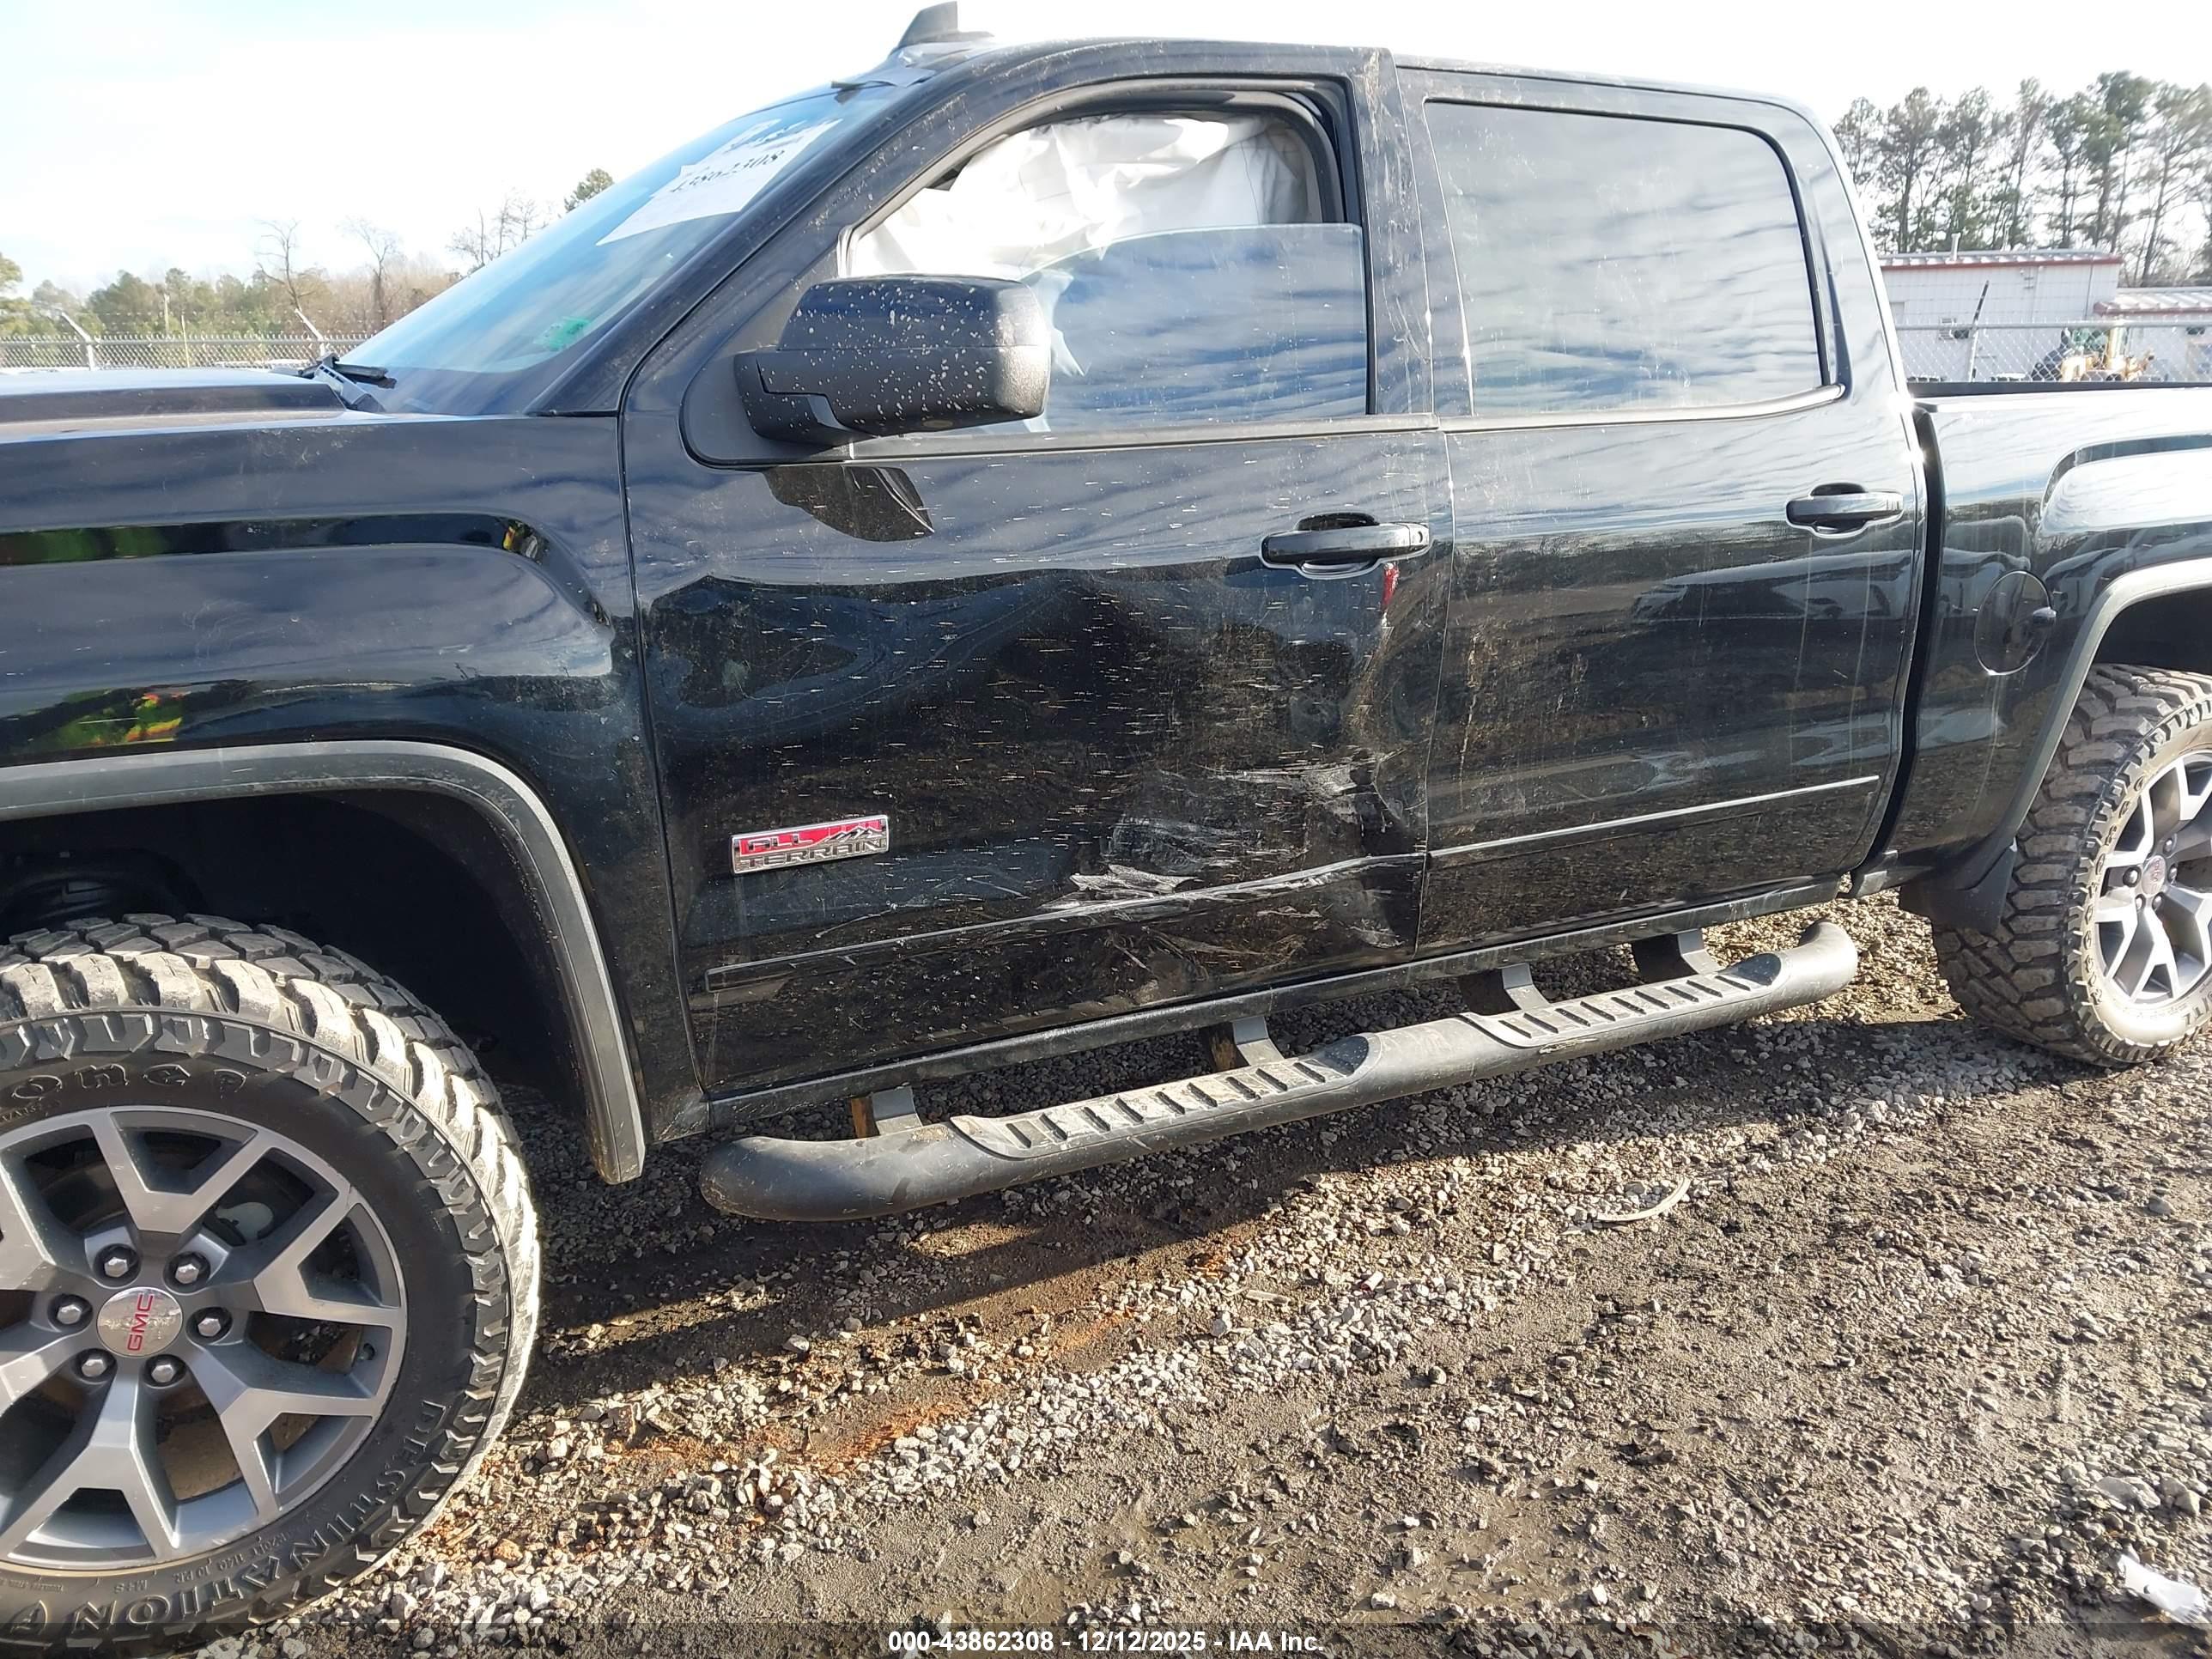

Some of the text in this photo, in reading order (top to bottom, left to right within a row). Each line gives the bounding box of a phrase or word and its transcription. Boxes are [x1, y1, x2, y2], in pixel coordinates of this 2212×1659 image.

[740, 839, 883, 869] TERRAIN
[747, 833, 813, 852] ALL
[127, 1292, 154, 1352] GMC
[69, 1399, 447, 1634] DESTINATION
